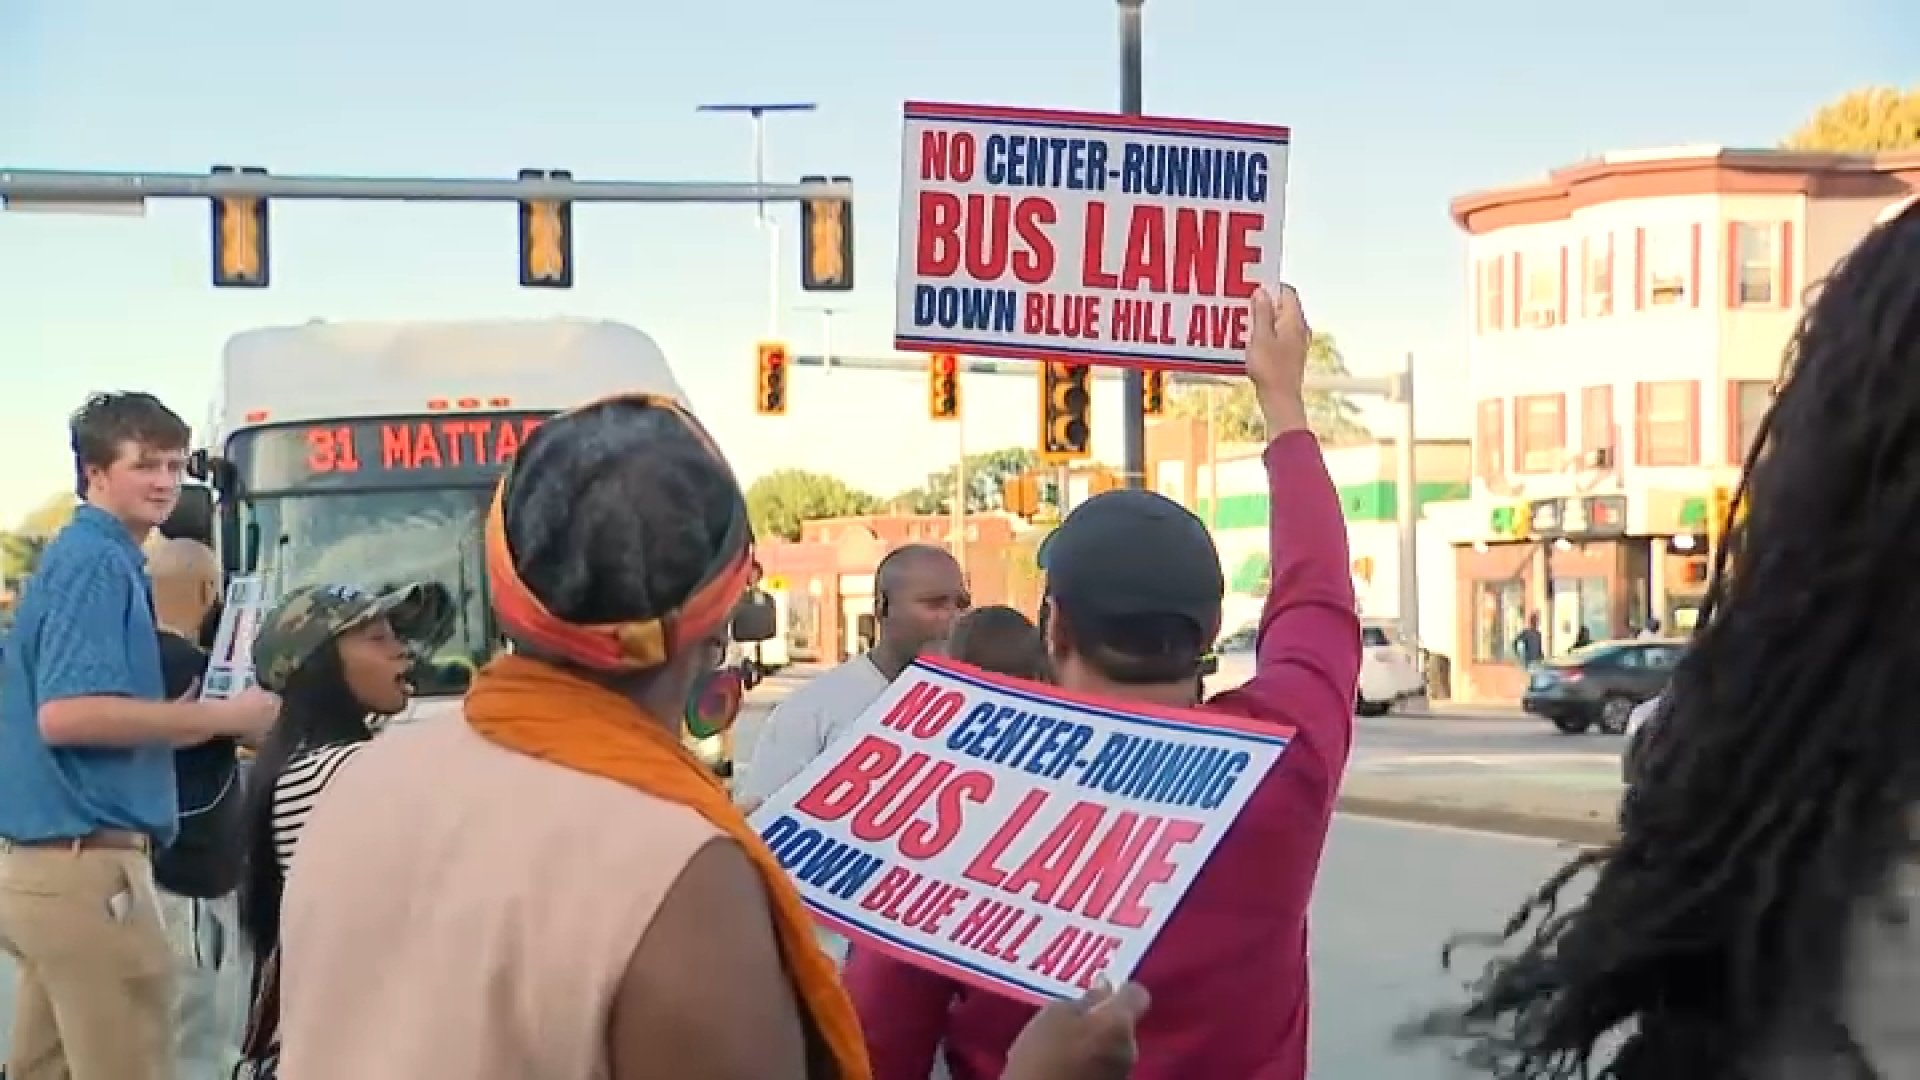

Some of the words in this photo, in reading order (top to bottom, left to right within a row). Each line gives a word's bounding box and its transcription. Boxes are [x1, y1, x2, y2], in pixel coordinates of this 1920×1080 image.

[920, 130, 976, 184] NO
[985, 133, 1269, 203] CENTER-RUNNING
[916, 190, 1057, 285] BUS
[1081, 201, 1265, 298] LANE
[914, 284, 1017, 333] DOWN
[1023, 292, 1100, 341] BLUE
[1111, 298, 1177, 346] HILL
[1186, 304, 1249, 349] AVE
[307, 425, 359, 472] 31
[881, 681, 966, 739] NO
[946, 701, 1252, 809] CENTER-RUNNING
[794, 734, 994, 861] BUS
[963, 789, 1205, 929] LANE
[762, 815, 884, 900] DOWN
[859, 865, 968, 934] BLUE
[949, 897, 1043, 963] HILL
[1028, 924, 1123, 989] AVE
